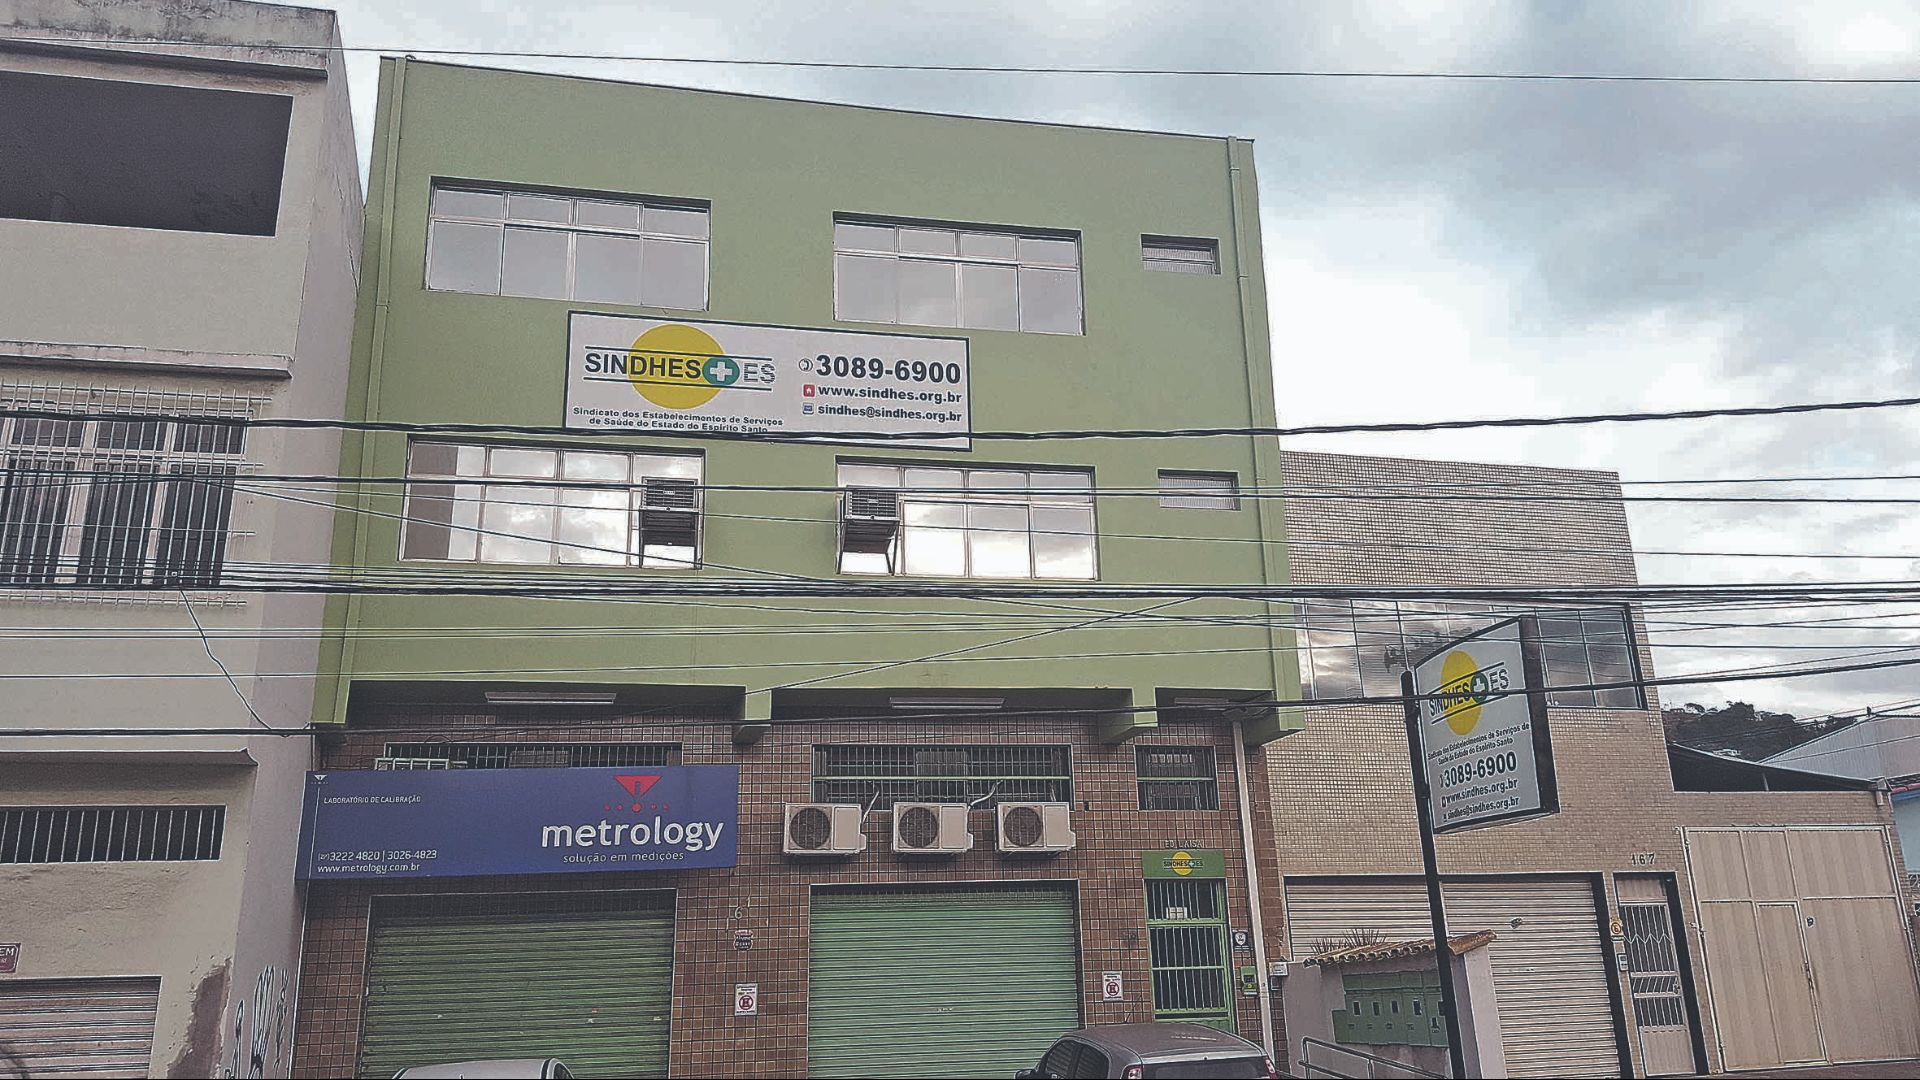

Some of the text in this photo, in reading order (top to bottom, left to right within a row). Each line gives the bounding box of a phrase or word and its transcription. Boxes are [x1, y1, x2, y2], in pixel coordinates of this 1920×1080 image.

[584, 353, 775, 384] SINDHES ES
[816, 354, 961, 384] 3089-6900
[818, 384, 962, 404] www.sindhes.org.br
[573, 407, 784, 427] Sindicato dos Estabelecimentos de Serviços
[818, 404, 962, 423] sindhes@sindhes.org.br
[589, 417, 768, 432] de Saúde do Estado do Espírito Santo
[1429, 669, 1509, 717] SINDHES ES
[1496, 725, 1520, 739] Serviços
[1522, 723, 1530, 731] de
[1497, 737, 1514, 748] Santo
[1444, 752, 1517, 788] 3089-6900
[324, 794, 369, 804] LABORATÓRIO
[380, 794, 421, 804] CALIBRAÇÃO
[1447, 778, 1518, 804] www.sindhes.org.br
[1447, 797, 1519, 820] sindhes@sindhes.org.br
[542, 815, 725, 852] metrology
[387, 850, 437, 861] 3026-4823
[563, 851, 685, 864] solução em medições
[1632, 853, 1655, 865] 167
[317, 863, 421, 875] www.metrology.com.br
